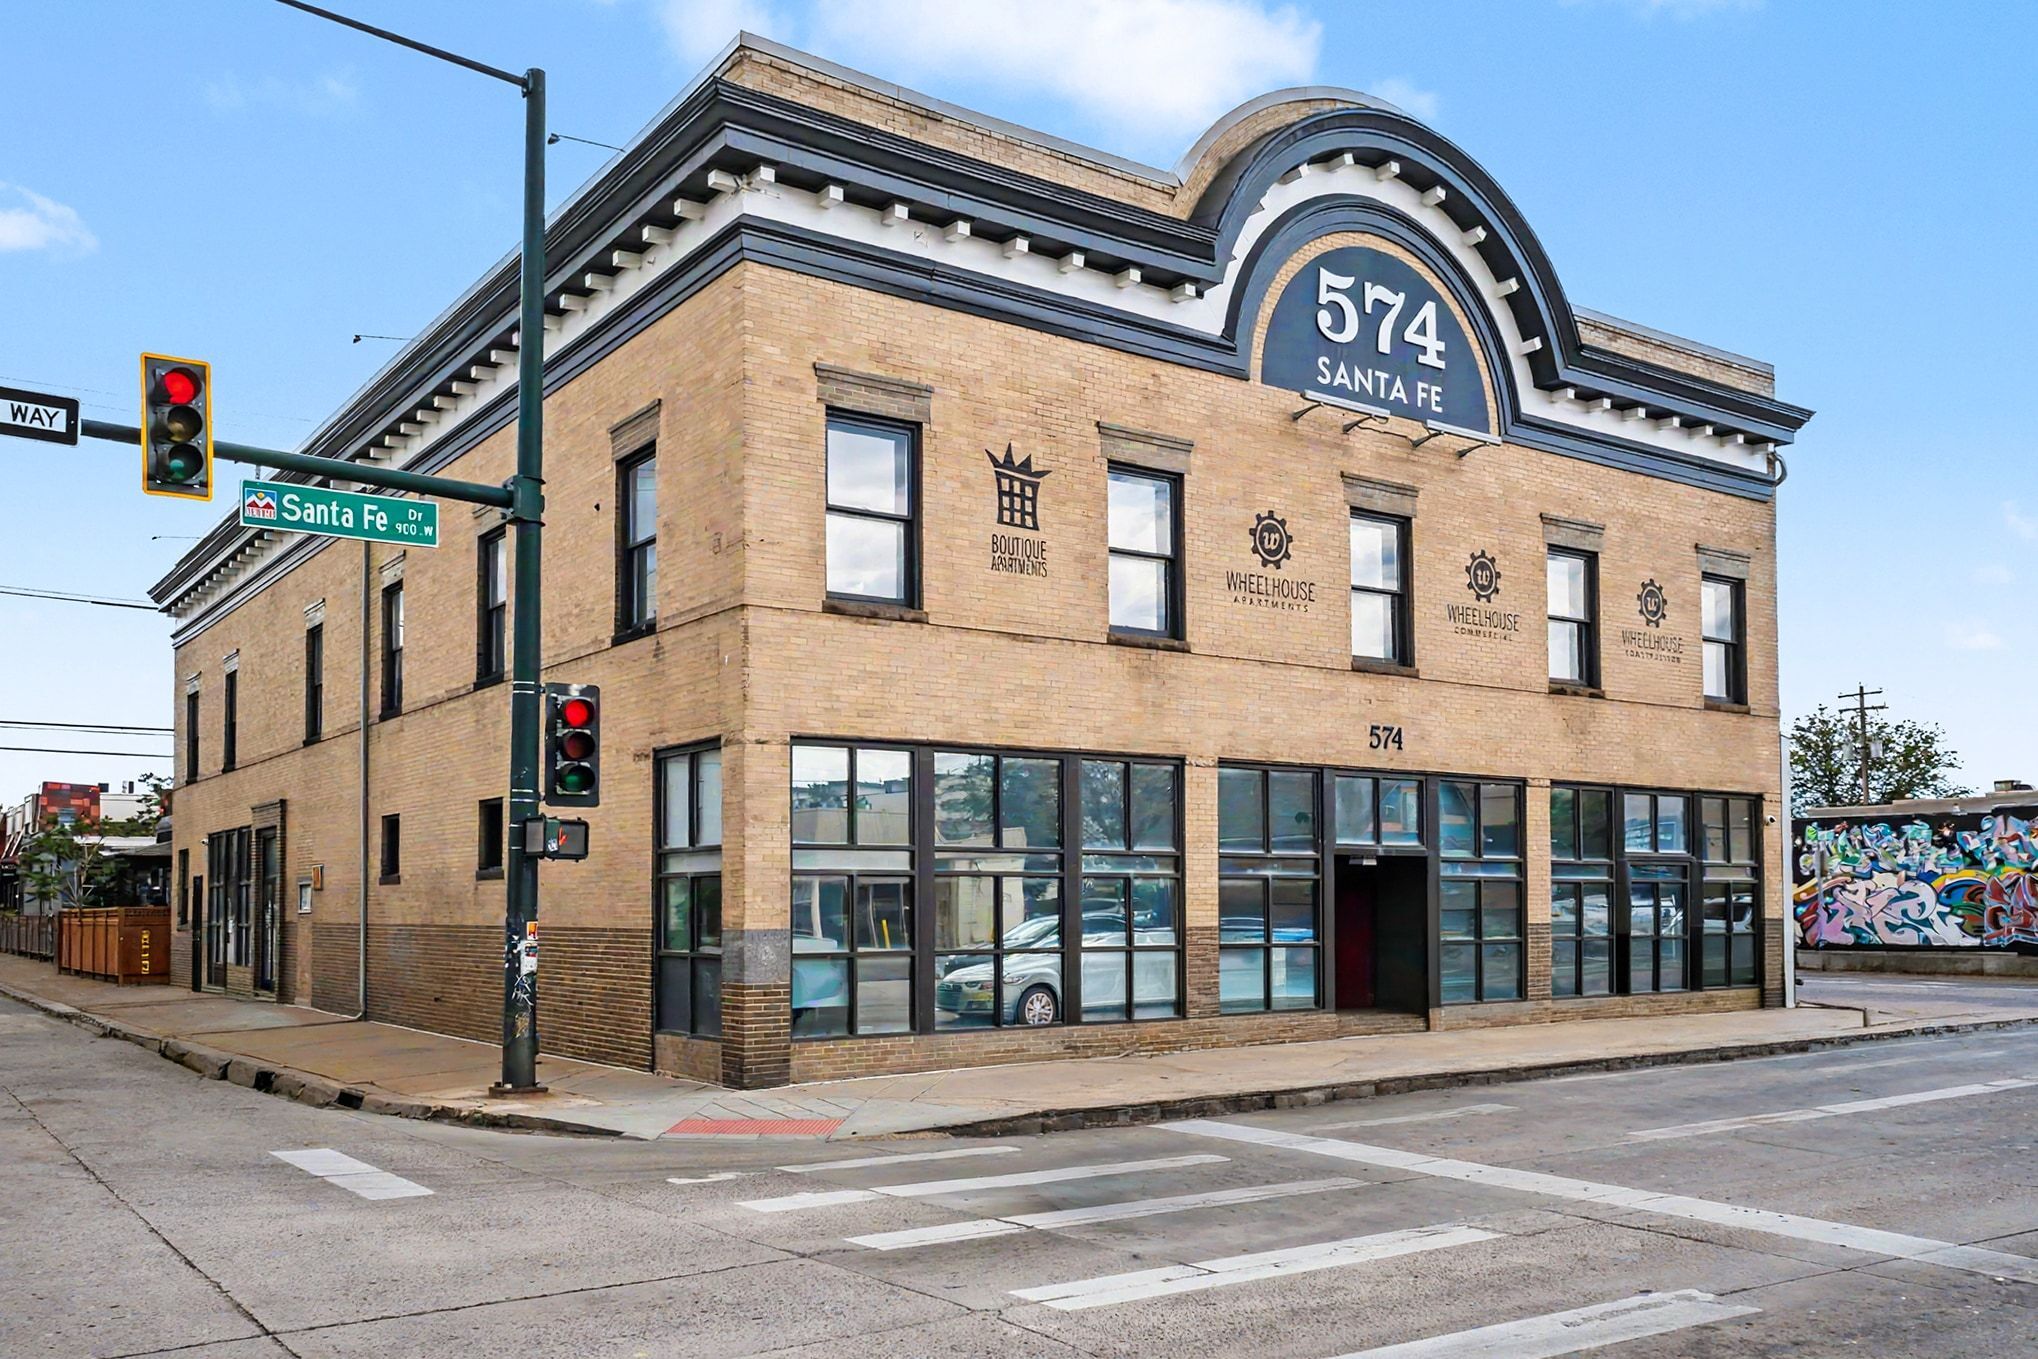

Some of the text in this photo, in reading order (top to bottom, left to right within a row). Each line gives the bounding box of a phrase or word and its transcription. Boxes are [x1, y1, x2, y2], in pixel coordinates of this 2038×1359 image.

[1316, 267, 1446, 370] 574
[1316, 356, 1443, 413] SANTA FE
[10, 403, 60, 428] WAY
[281, 493, 354, 528] Santa
[363, 503, 389, 531] Fe
[408, 508, 423, 521] Dr
[395, 523, 417, 536] 900
[991, 533, 1047, 561] BOUTIQUE
[991, 555, 1048, 578] APARTMENTS
[1226, 570, 1315, 602] WHEELHOUSE
[1233, 595, 1309, 613] APARTMENTS
[1446, 603, 1520, 632] WHEELHOUSE
[1621, 630, 1683, 654] WHEELHOUSE
[1369, 725, 1403, 751] 574
